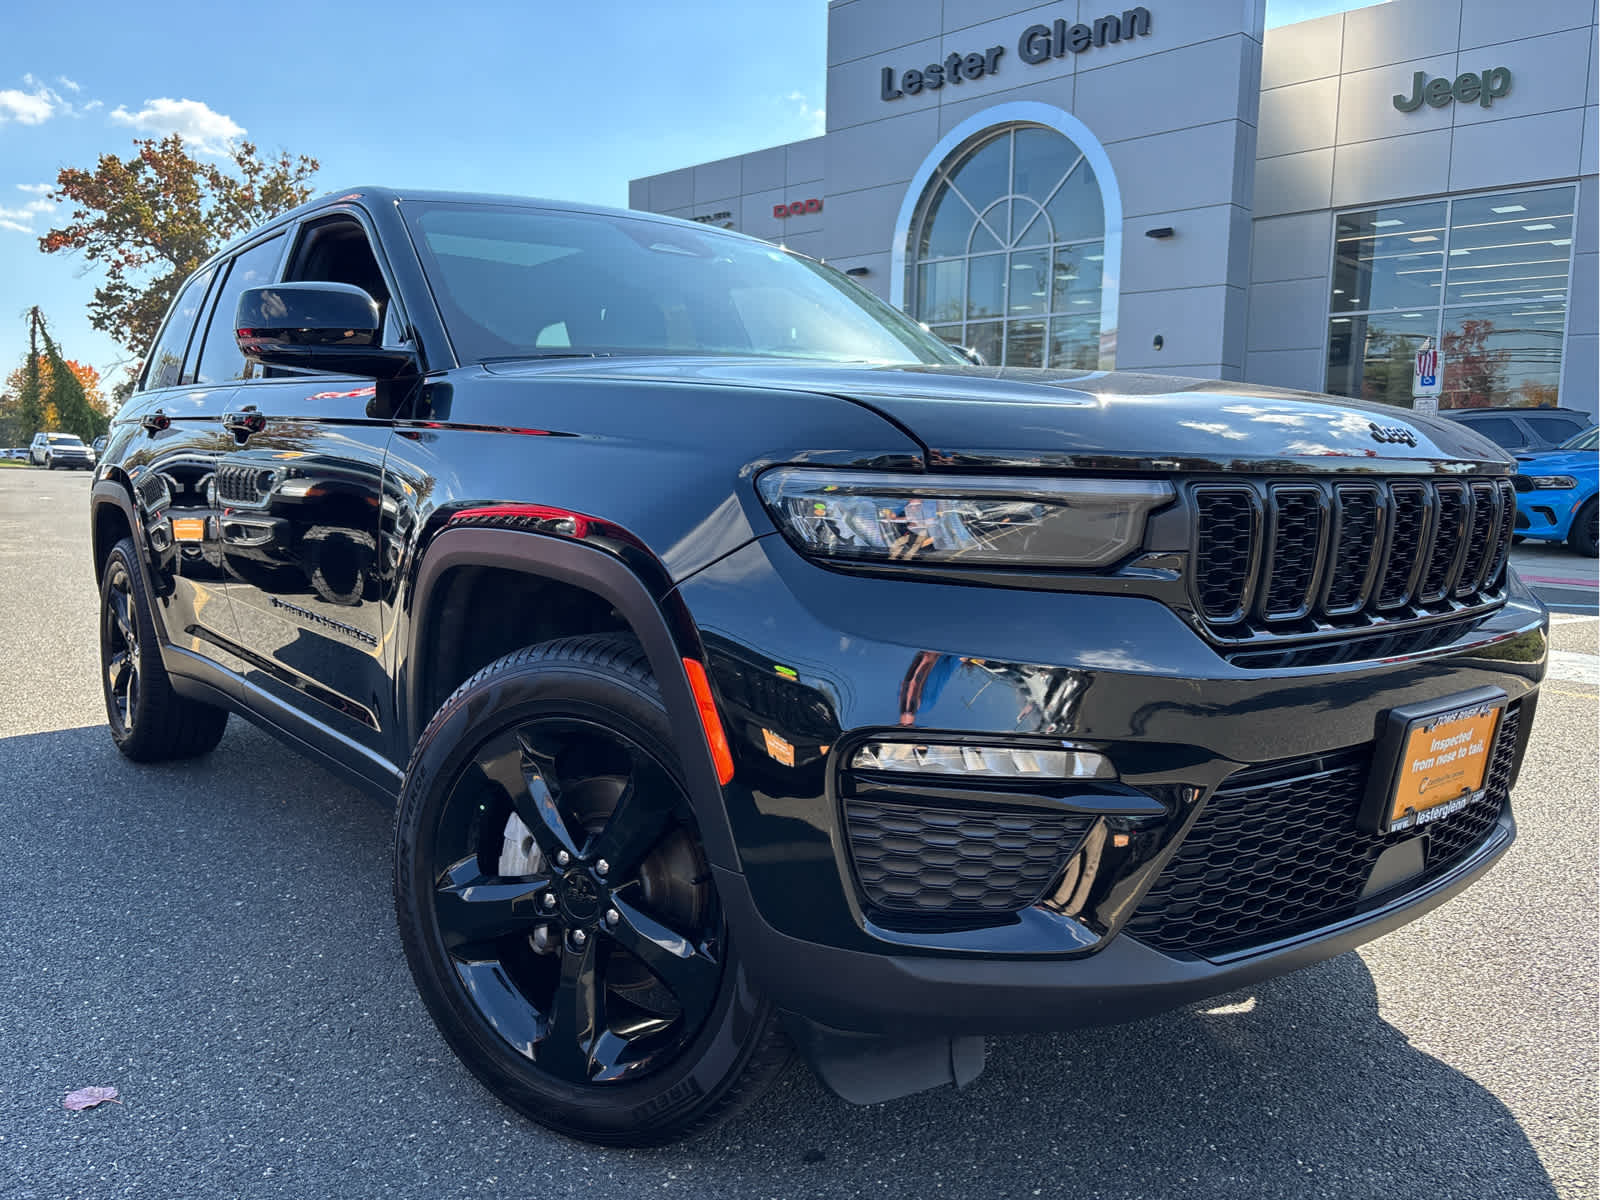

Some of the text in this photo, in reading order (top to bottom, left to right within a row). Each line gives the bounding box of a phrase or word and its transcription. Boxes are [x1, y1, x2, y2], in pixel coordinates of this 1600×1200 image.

[880, 6, 1151, 102] Lester Glenn
[1392, 66, 1511, 112] Jeep
[773, 198, 824, 218] DOD
[1368, 422, 1417, 448] Jeep
[1430, 728, 1474, 752] Inspected
[1412, 757, 1435, 774] from
[1436, 751, 1457, 767] nose
[1457, 746, 1467, 759] to
